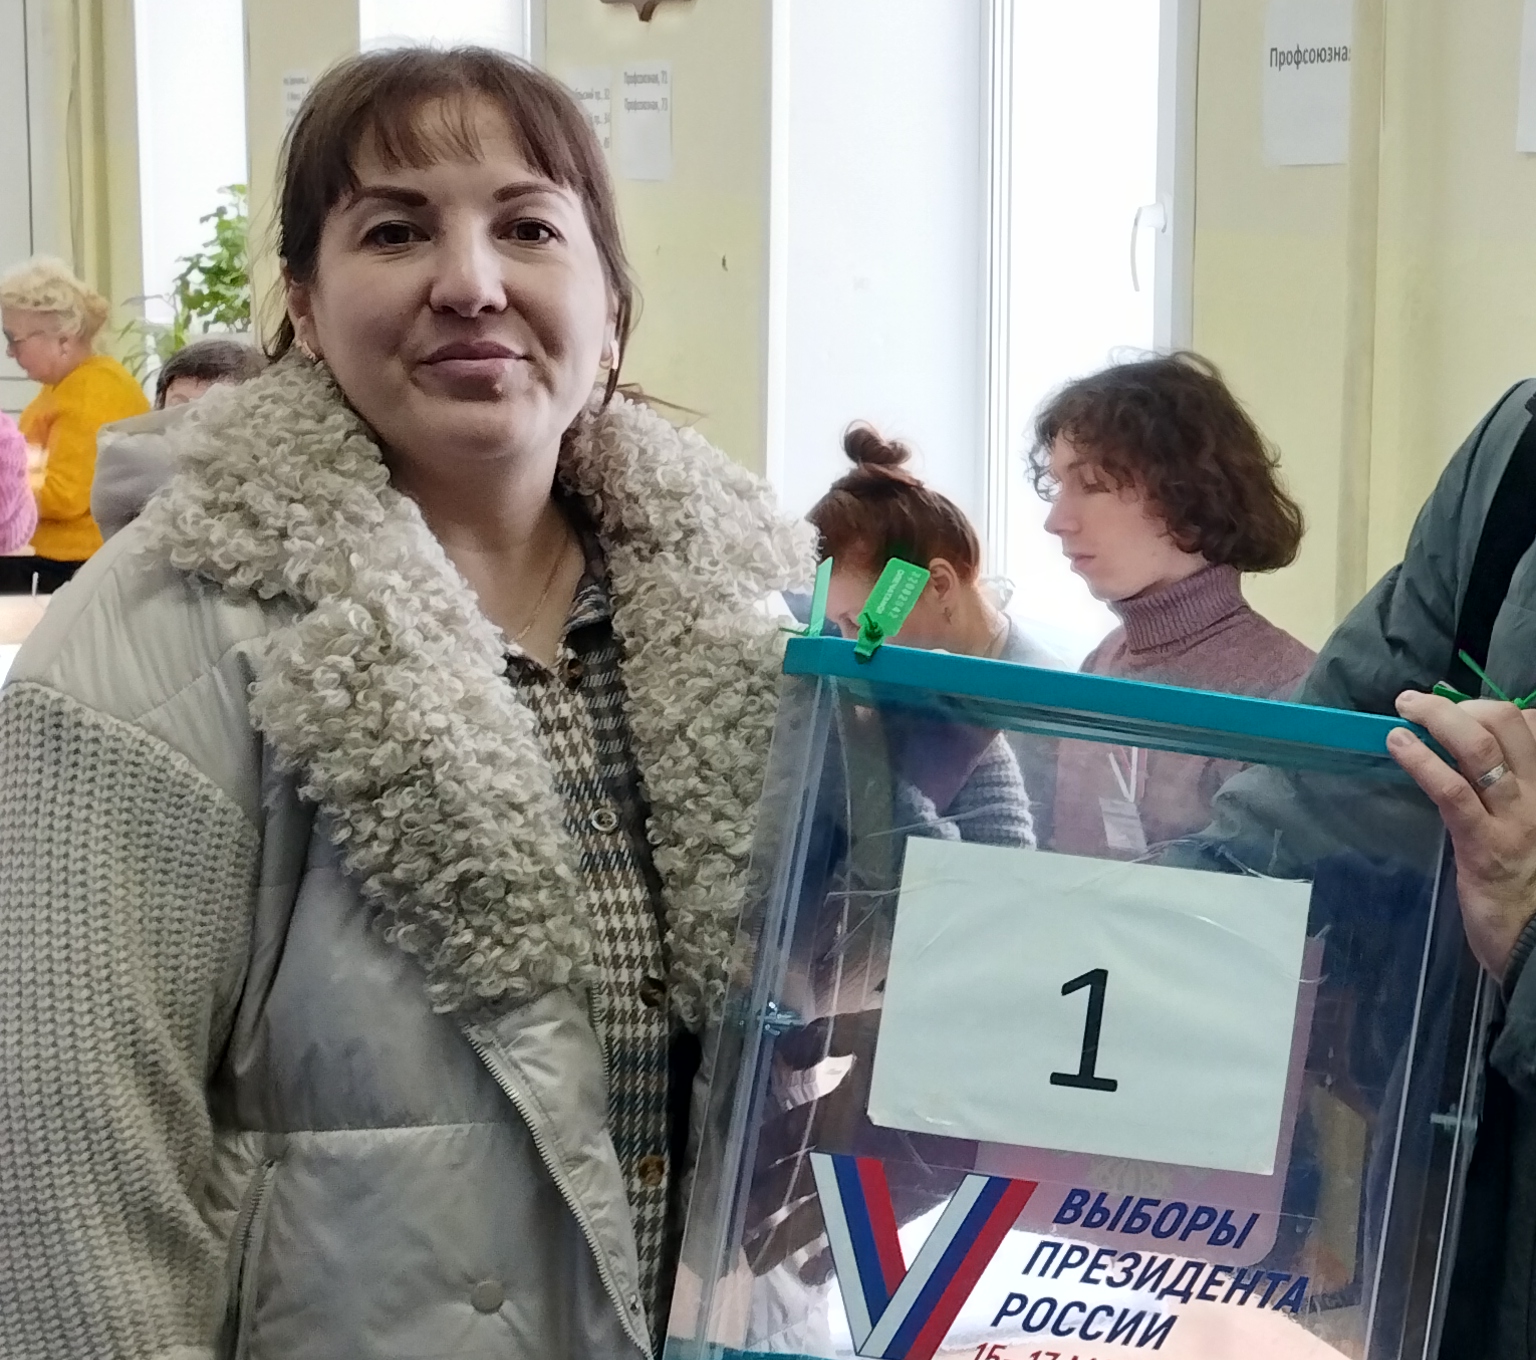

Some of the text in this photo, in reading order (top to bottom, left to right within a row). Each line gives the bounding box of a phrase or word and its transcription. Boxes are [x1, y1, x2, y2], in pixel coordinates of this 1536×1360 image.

[1269, 42, 1351, 72] Профсоюзна
[1049, 967, 1118, 1092] 1
[1052, 1188, 1261, 1249] ВЫБОРЫ
[1021, 1240, 1309, 1314] ПРЕЗИДЕНТА
[990, 1291, 1179, 1351] РОССИИ
